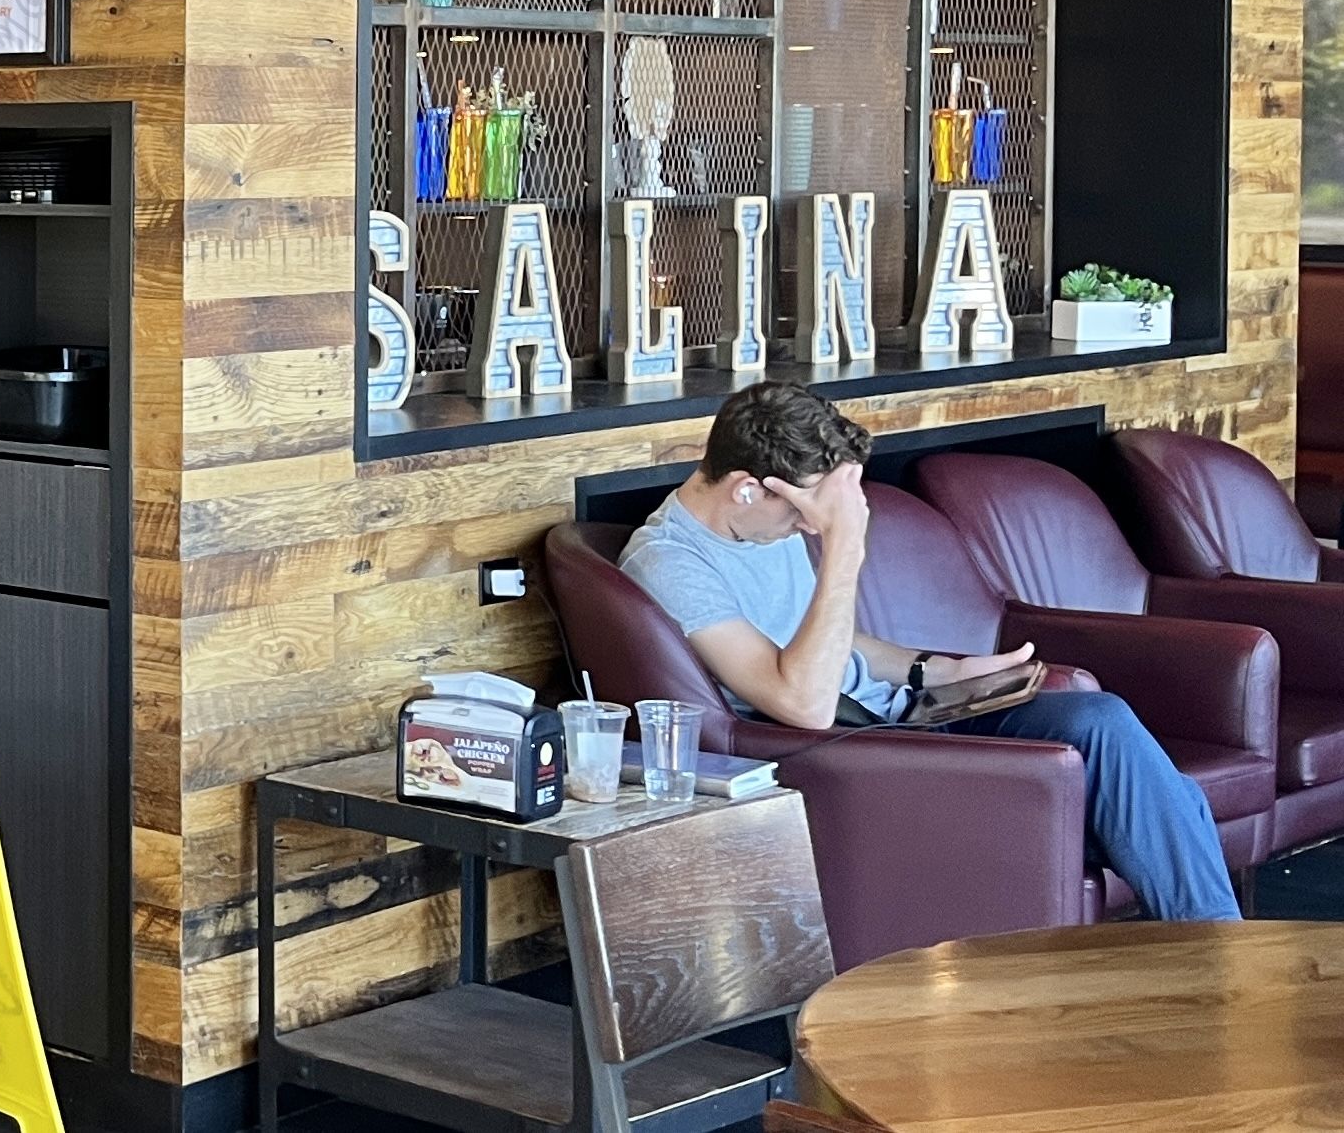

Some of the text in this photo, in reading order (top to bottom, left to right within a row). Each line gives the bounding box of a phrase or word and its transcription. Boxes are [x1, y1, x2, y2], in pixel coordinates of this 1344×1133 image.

[368, 189, 1013, 410] SALINA
[453, 736, 510, 755] JALAPEÑO
[456, 749, 506, 765] CHICKEN
[470, 766, 493, 774] WRAP
